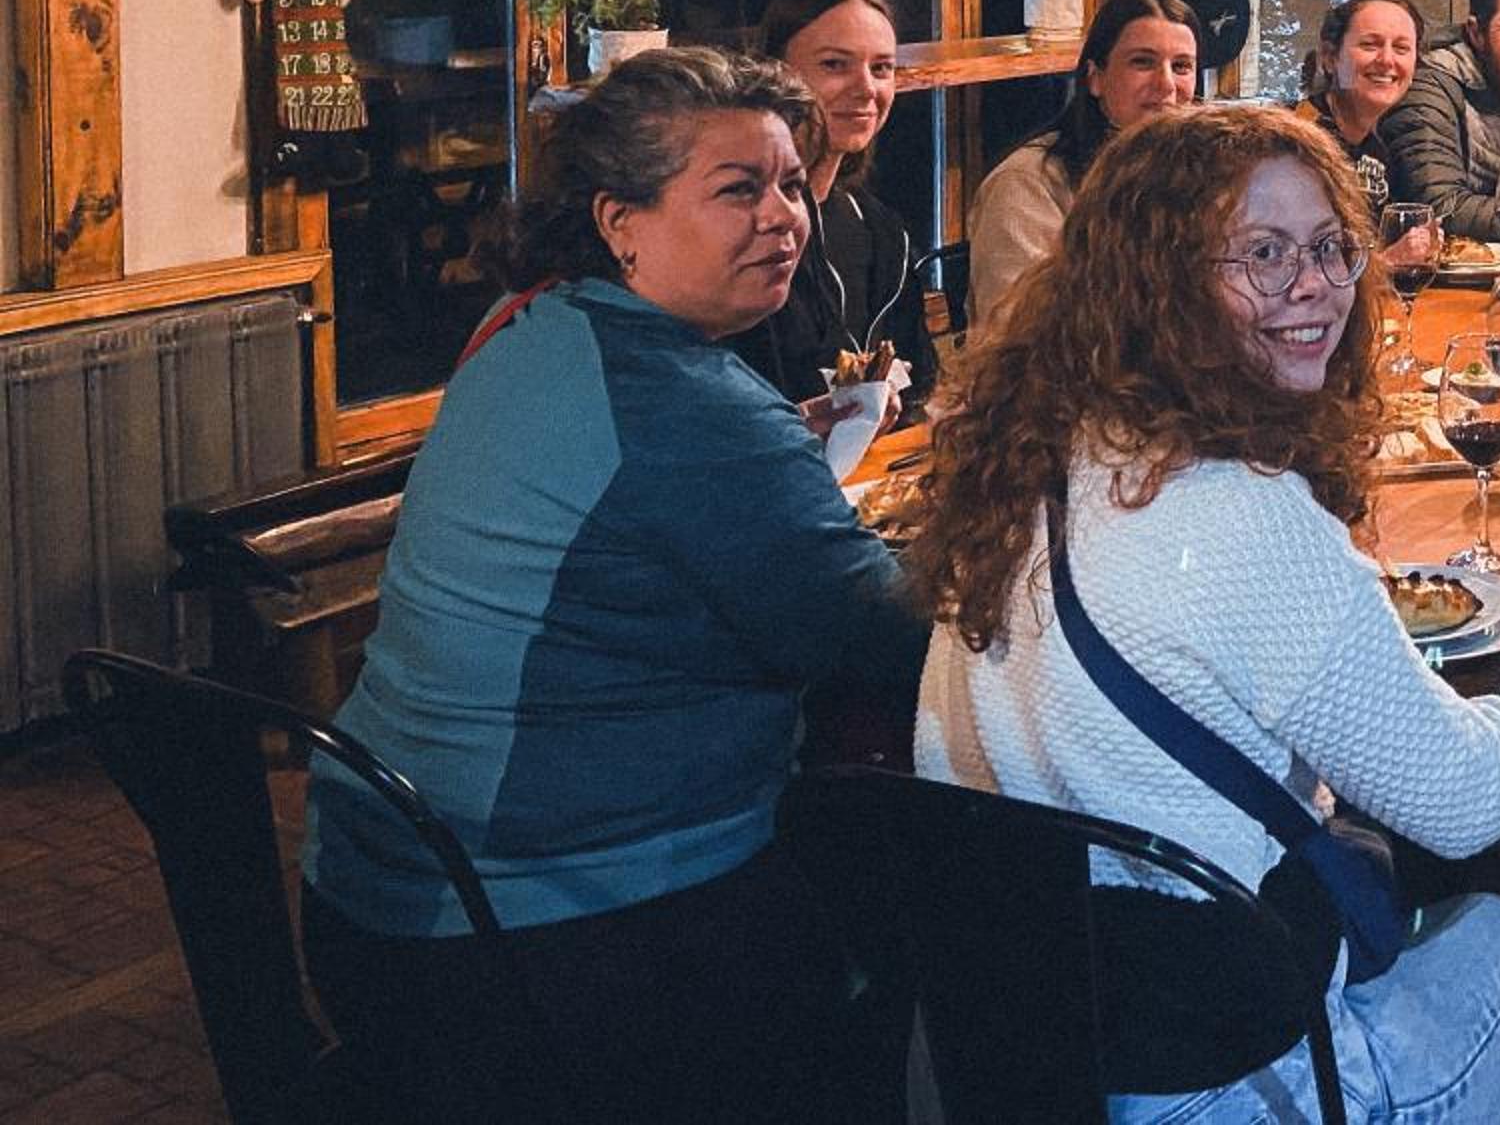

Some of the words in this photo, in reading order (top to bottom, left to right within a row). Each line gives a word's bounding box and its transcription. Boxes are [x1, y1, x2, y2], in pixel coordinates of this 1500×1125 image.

[277, 20, 301, 44] 13
[309, 19, 328, 42] 14
[281, 54, 302, 76] 17
[312, 52, 331, 75] 18
[284, 86, 305, 107] 21
[311, 85, 334, 106] 22
